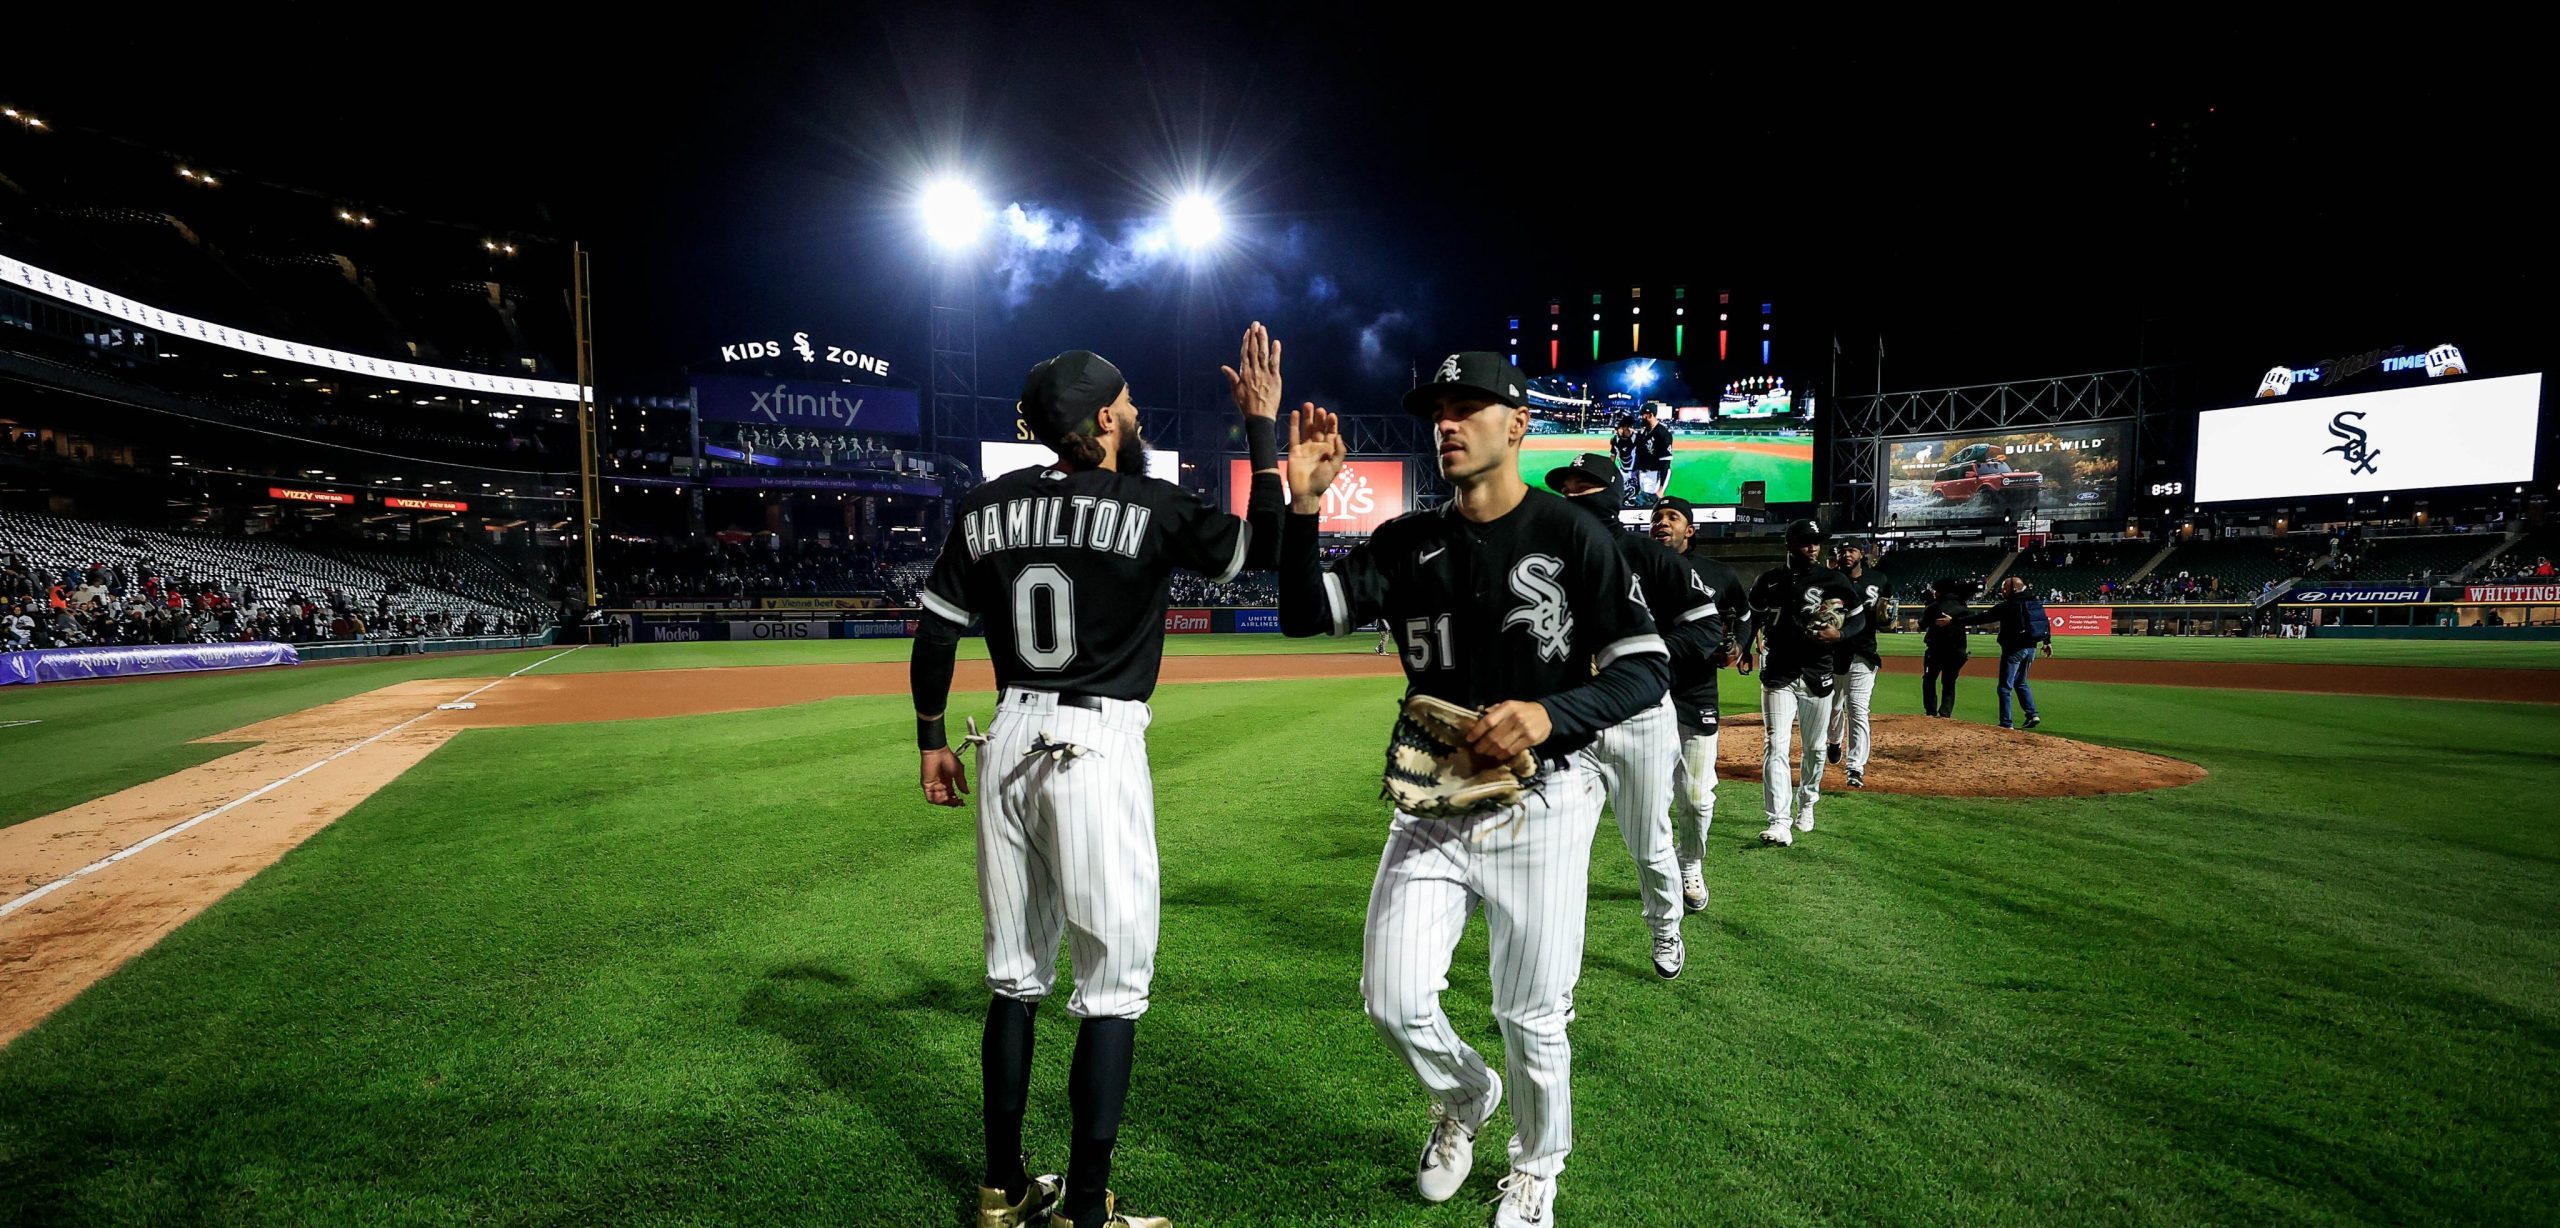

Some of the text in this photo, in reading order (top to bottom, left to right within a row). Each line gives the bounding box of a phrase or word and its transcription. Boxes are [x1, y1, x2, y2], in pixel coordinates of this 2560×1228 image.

[721, 341, 781, 363] KIDS
[826, 346, 890, 376] ZONE
[2289, 367, 2320, 384] IT'S
[2381, 353, 2425, 372] TIME
[751, 384, 864, 427] xfinity
[2005, 443, 2053, 455] BUILT
[282, 490, 313, 501] VIZZY
[2151, 482, 2182, 496] 8:53
[397, 499, 428, 509] VIZZY
[963, 495, 1151, 564] HAMILTON
[814, 599, 833, 607] Beef
[2330, 591, 2419, 601] HYUNDAI
[1012, 563, 1078, 672] 0
[654, 626, 700, 641] Modelo
[753, 623, 808, 639] ORIS
[854, 622, 904, 636] guaranteed
[1405, 613, 1456, 672] 51
